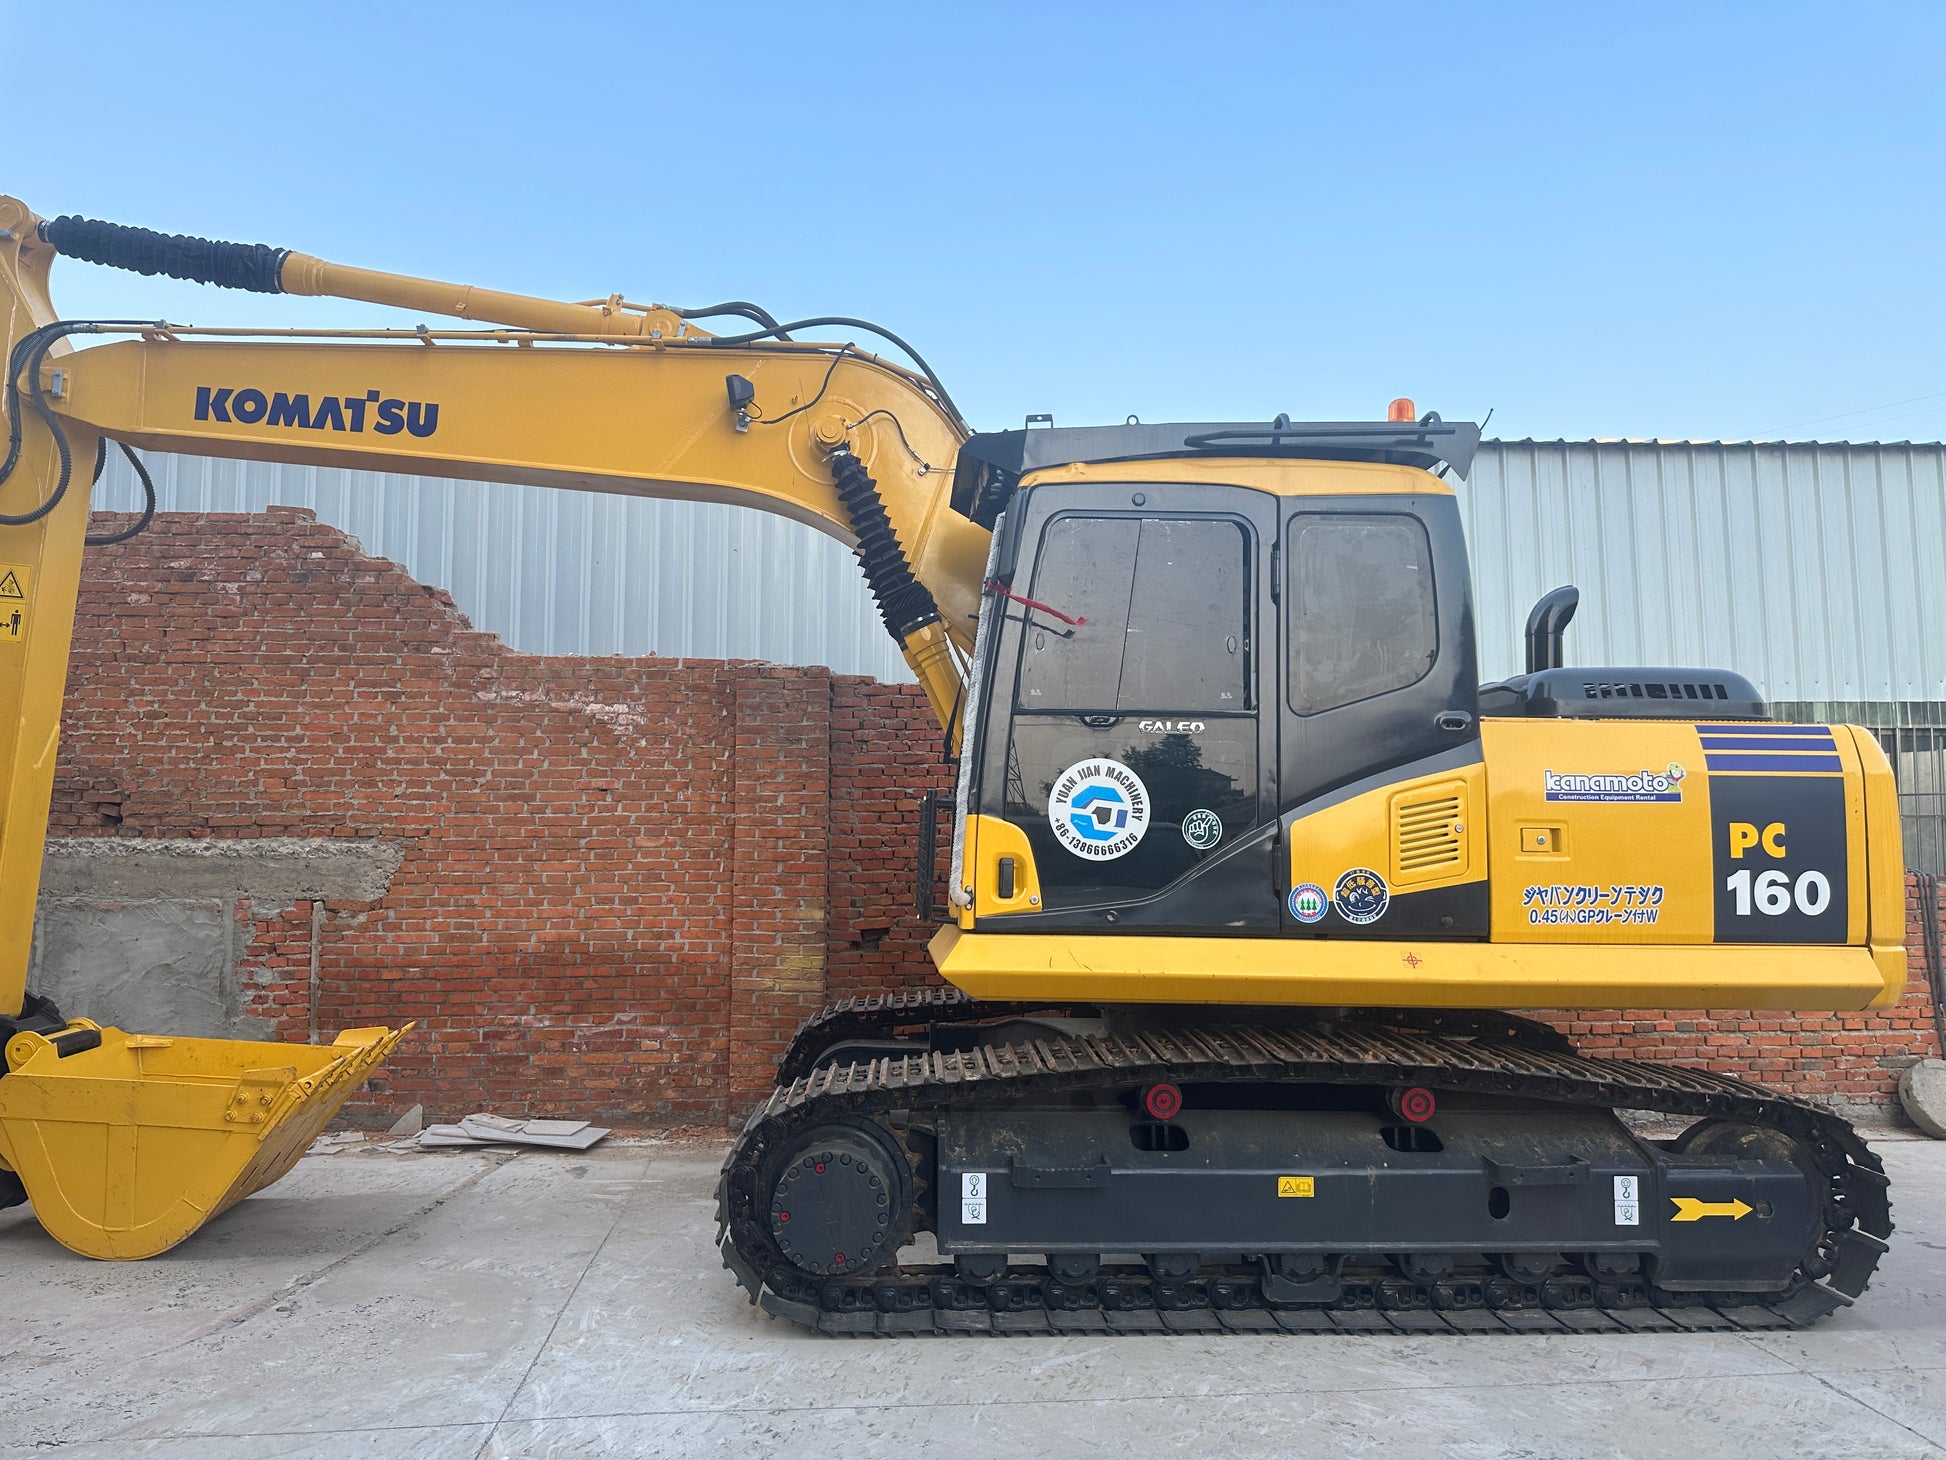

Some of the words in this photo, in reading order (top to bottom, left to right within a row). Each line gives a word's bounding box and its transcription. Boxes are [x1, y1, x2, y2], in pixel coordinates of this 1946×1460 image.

[194, 386, 439, 438] KOMATSU
[1055, 776, 1078, 804] YUAN
[1077, 765, 1101, 781] JIAN
[1105, 766, 1144, 822] MACHINERY
[1545, 770, 1669, 792] kanamoto
[1729, 822, 1786, 858] PC
[1727, 869, 1831, 916] 160
